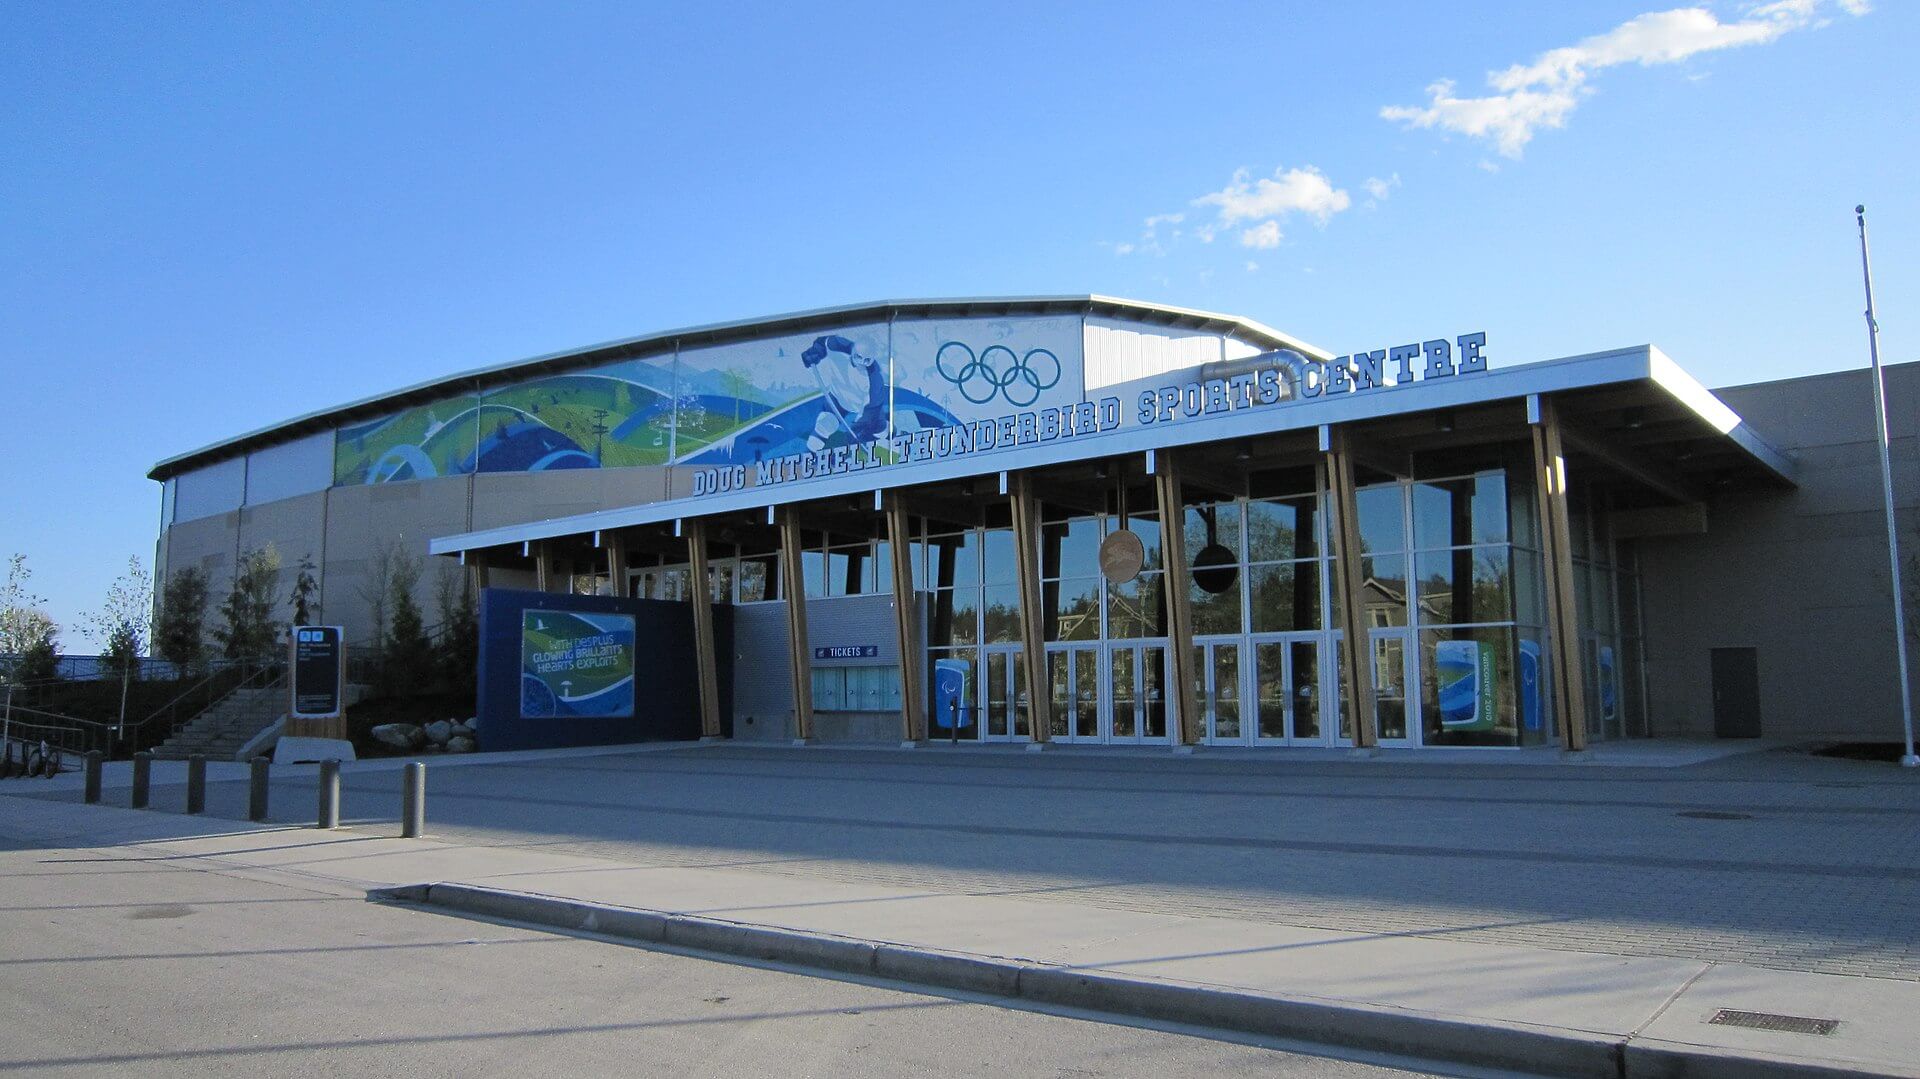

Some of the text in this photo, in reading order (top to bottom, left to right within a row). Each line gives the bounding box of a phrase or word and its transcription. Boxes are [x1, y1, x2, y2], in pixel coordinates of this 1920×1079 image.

[692, 331, 1488, 498] DOUG MITCHELL THUNDERBIRD SPORTS CENTRE
[830, 646, 861, 657] TICKETS
